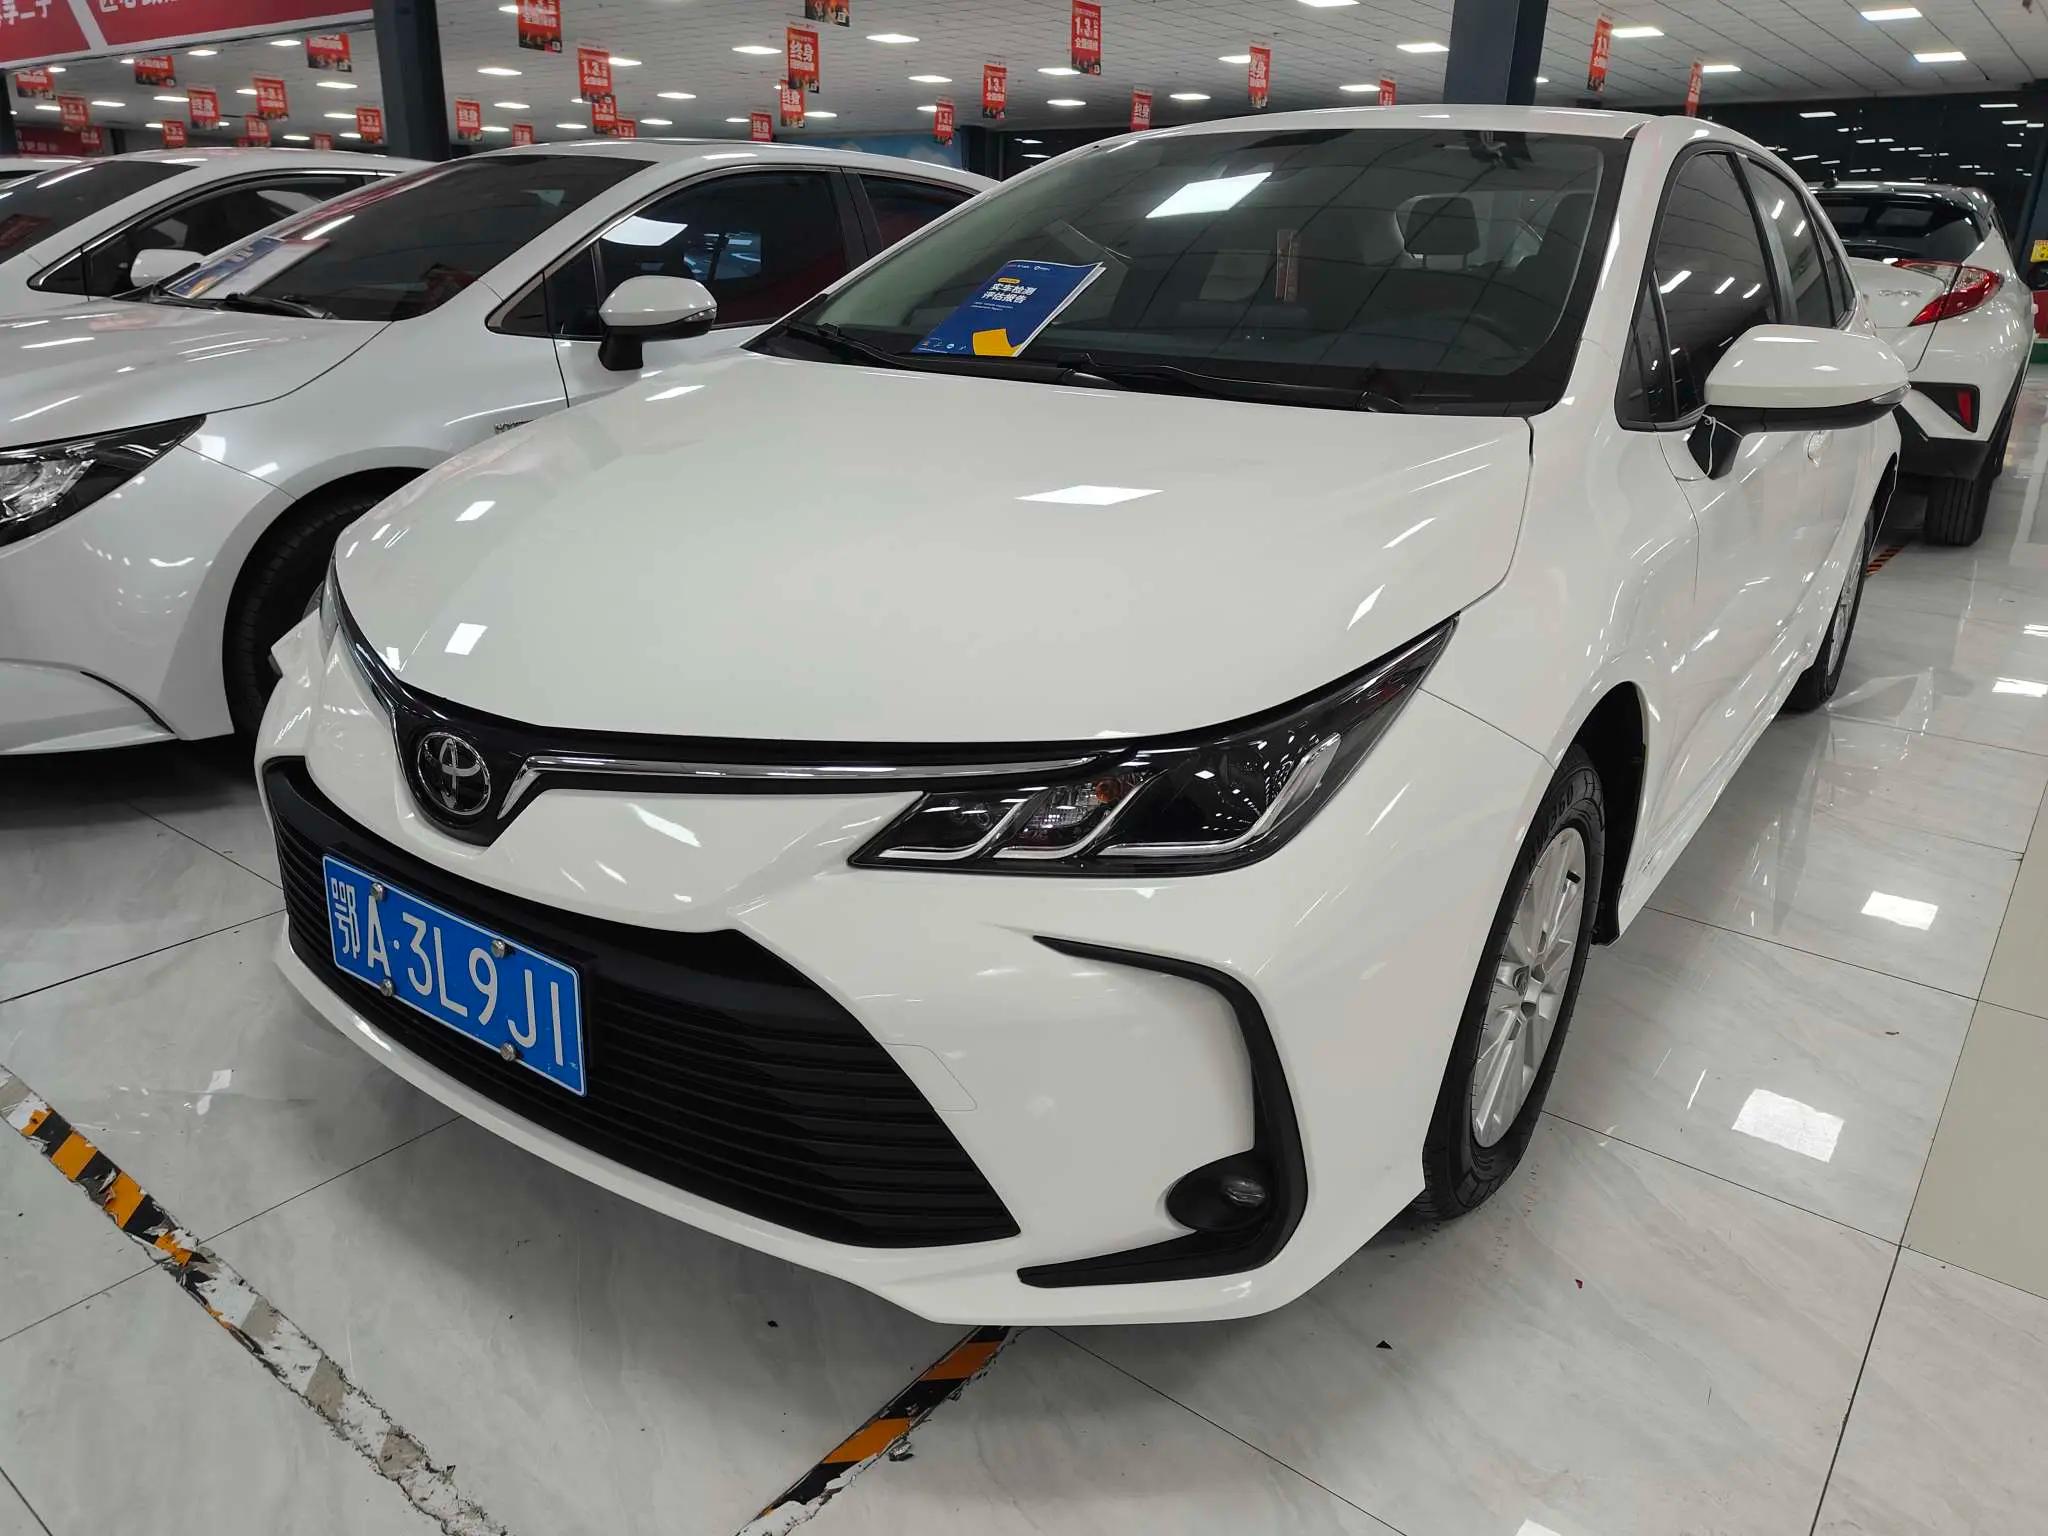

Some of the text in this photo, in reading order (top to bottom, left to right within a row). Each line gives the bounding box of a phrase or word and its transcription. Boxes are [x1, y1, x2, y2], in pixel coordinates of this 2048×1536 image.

[989, 283, 1037, 296] 实车检测
[981, 291, 1027, 303] 评估报告
